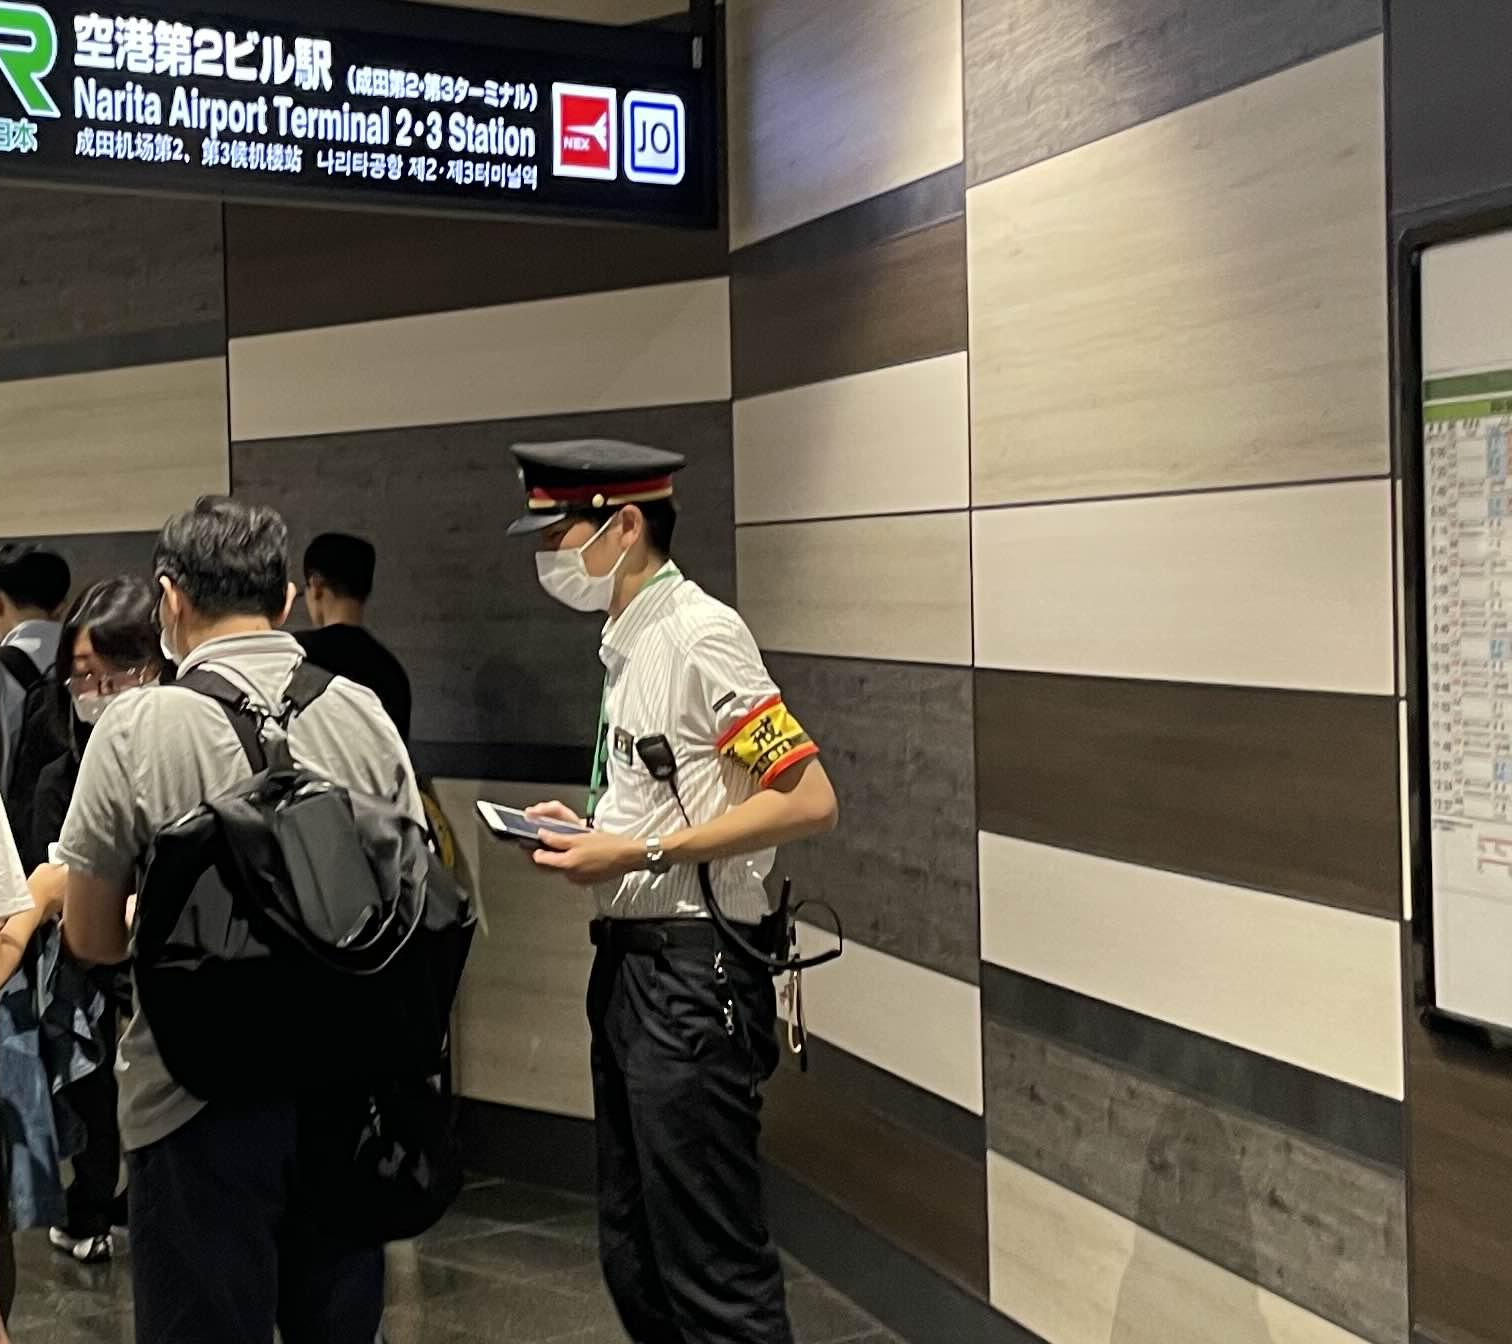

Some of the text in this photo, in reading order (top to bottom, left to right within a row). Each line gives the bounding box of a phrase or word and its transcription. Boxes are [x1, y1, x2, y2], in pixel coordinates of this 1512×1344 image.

[73, 13, 333, 93] 空港第2ビル駅
[73, 76, 163, 125] Narita
[168, 89, 267, 139] Airport
[274, 95, 389, 146] Terminal
[448, 118, 535, 159] Station
[637, 120, 671, 154] JO
[317, 149, 404, 182] 나리타공항
